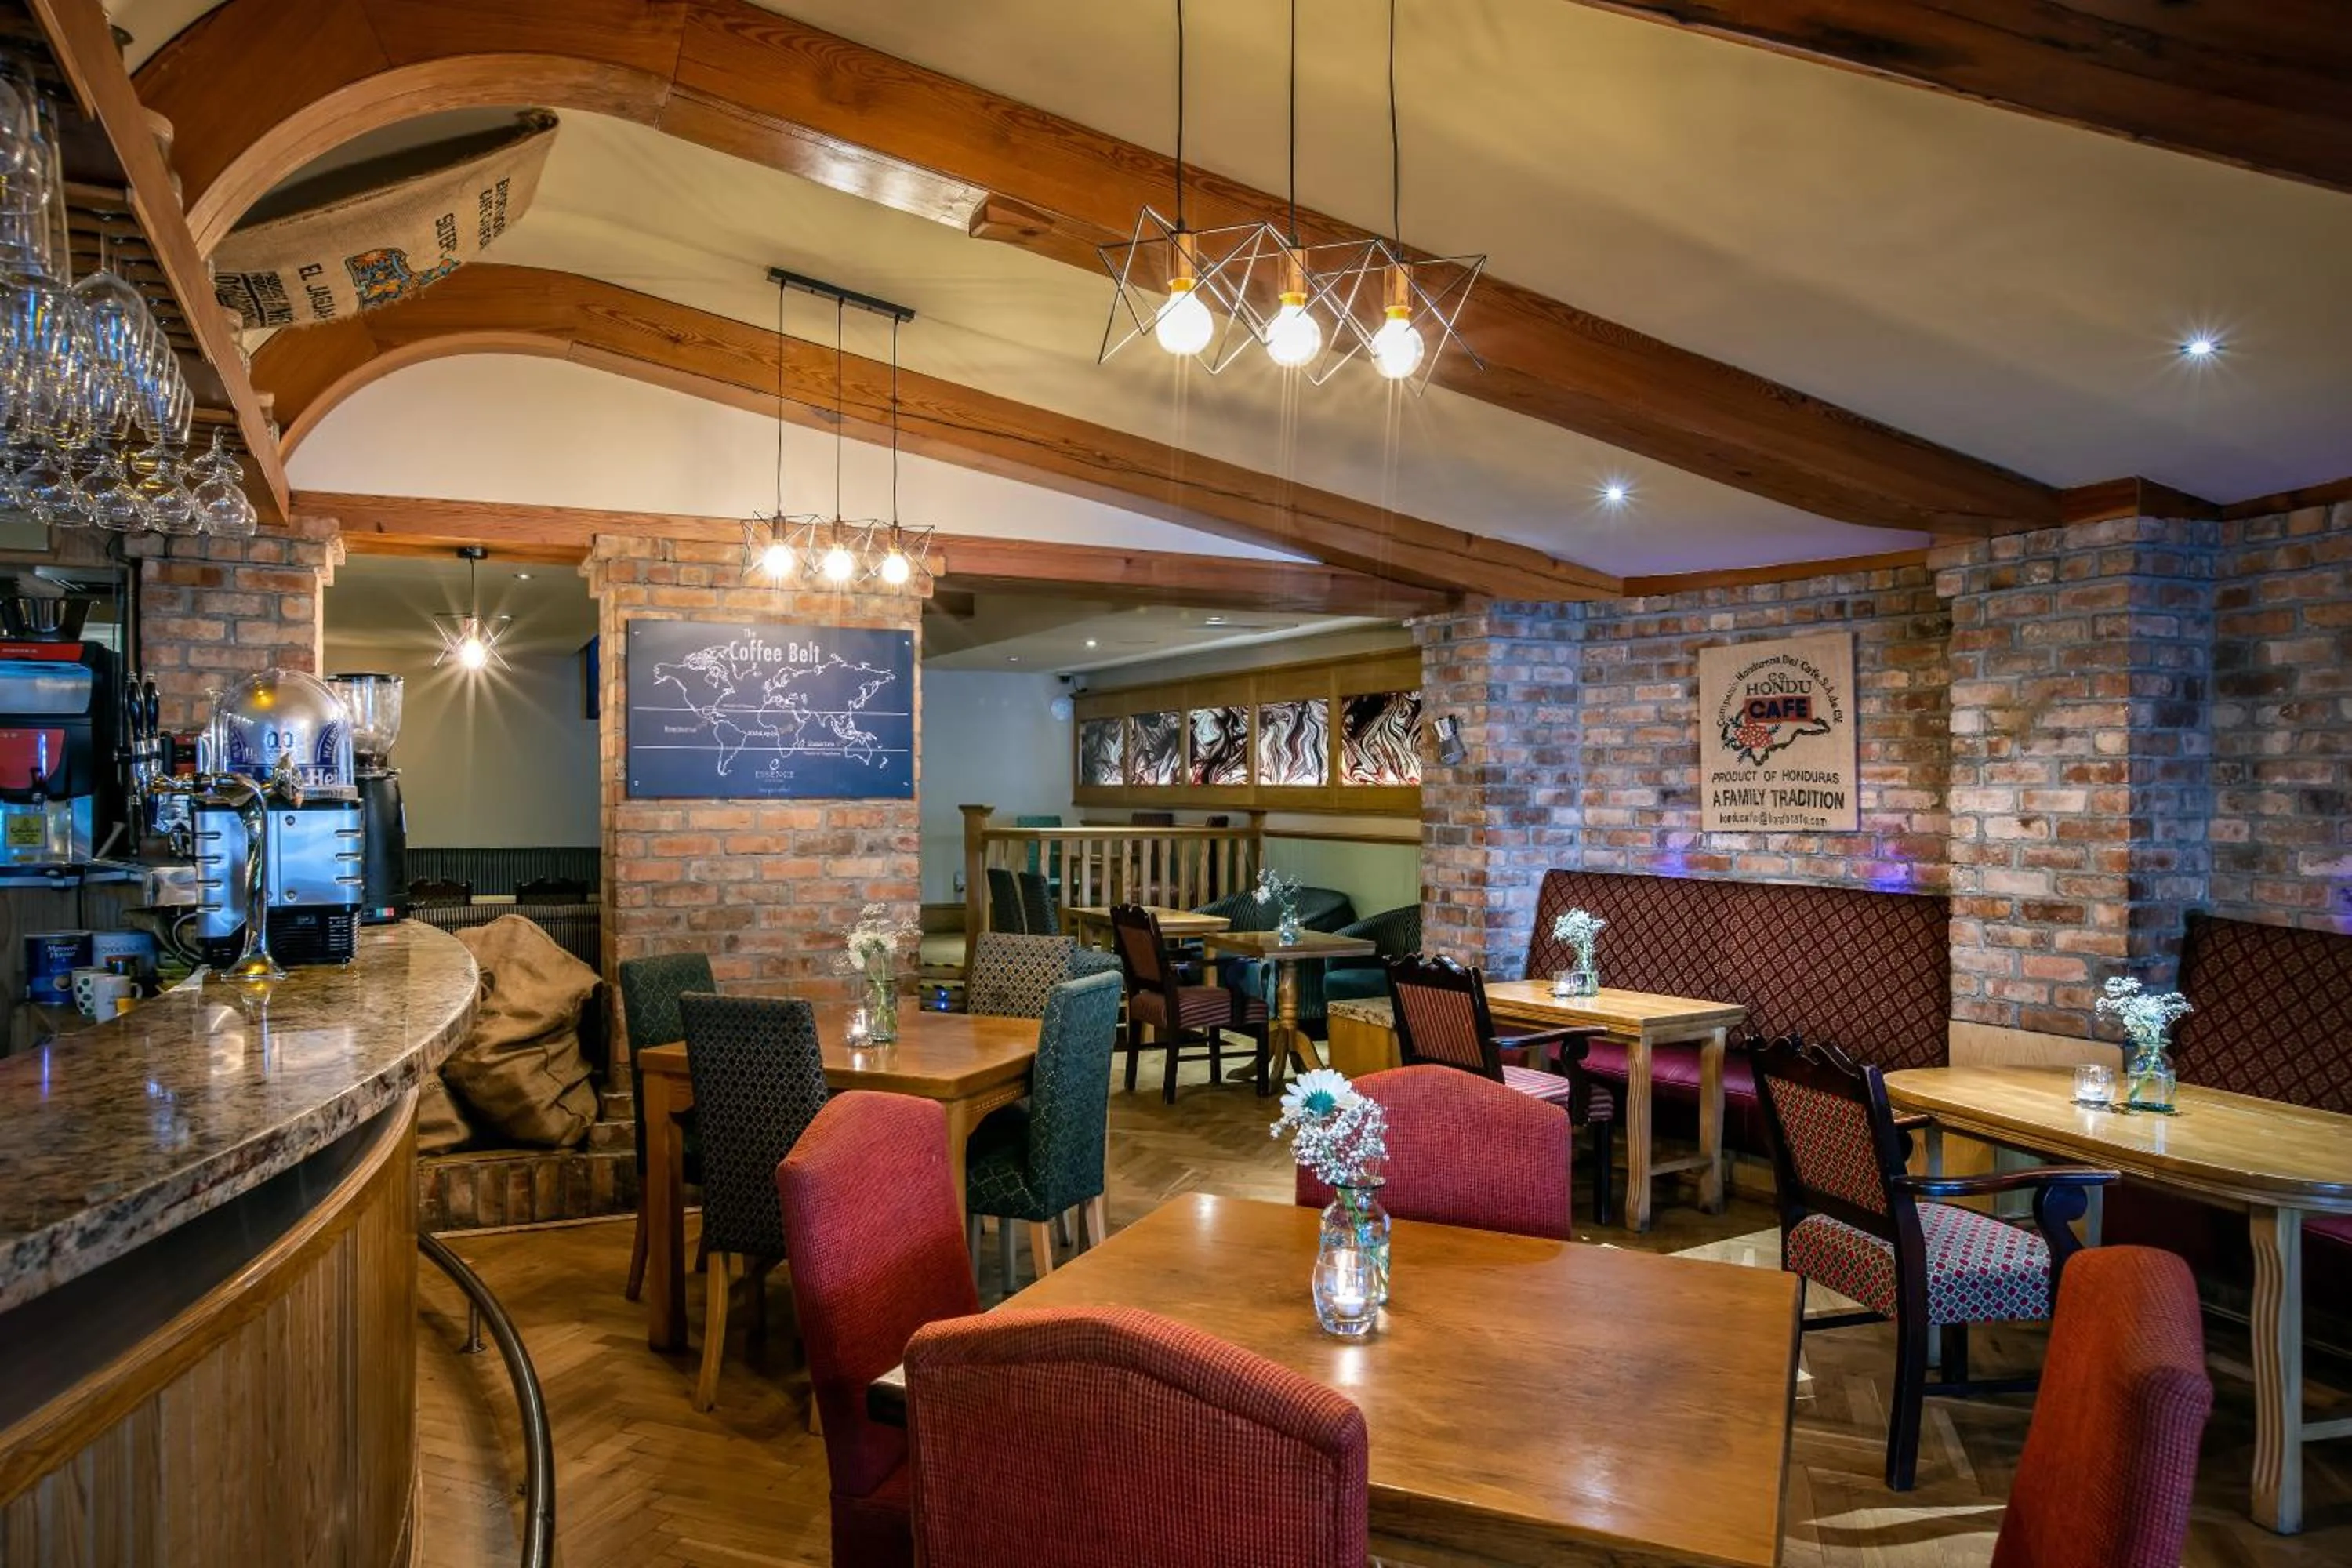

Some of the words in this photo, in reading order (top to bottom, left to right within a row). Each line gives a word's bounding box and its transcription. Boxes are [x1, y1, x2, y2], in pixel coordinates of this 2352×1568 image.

[299, 263, 324, 281] EL
[730, 640, 782, 662] Coffee
[789, 641, 820, 663] Belt
[1746, 680, 1813, 695] HONDU
[1749, 698, 1807, 719] CAFE
[1711, 770, 1758, 783] PRODUCT
[1764, 771, 1777, 782] OF
[1782, 769, 1840, 785] HONDURAS
[1722, 789, 1766, 807] FAMILY
[1770, 789, 1844, 810] TRADITION
